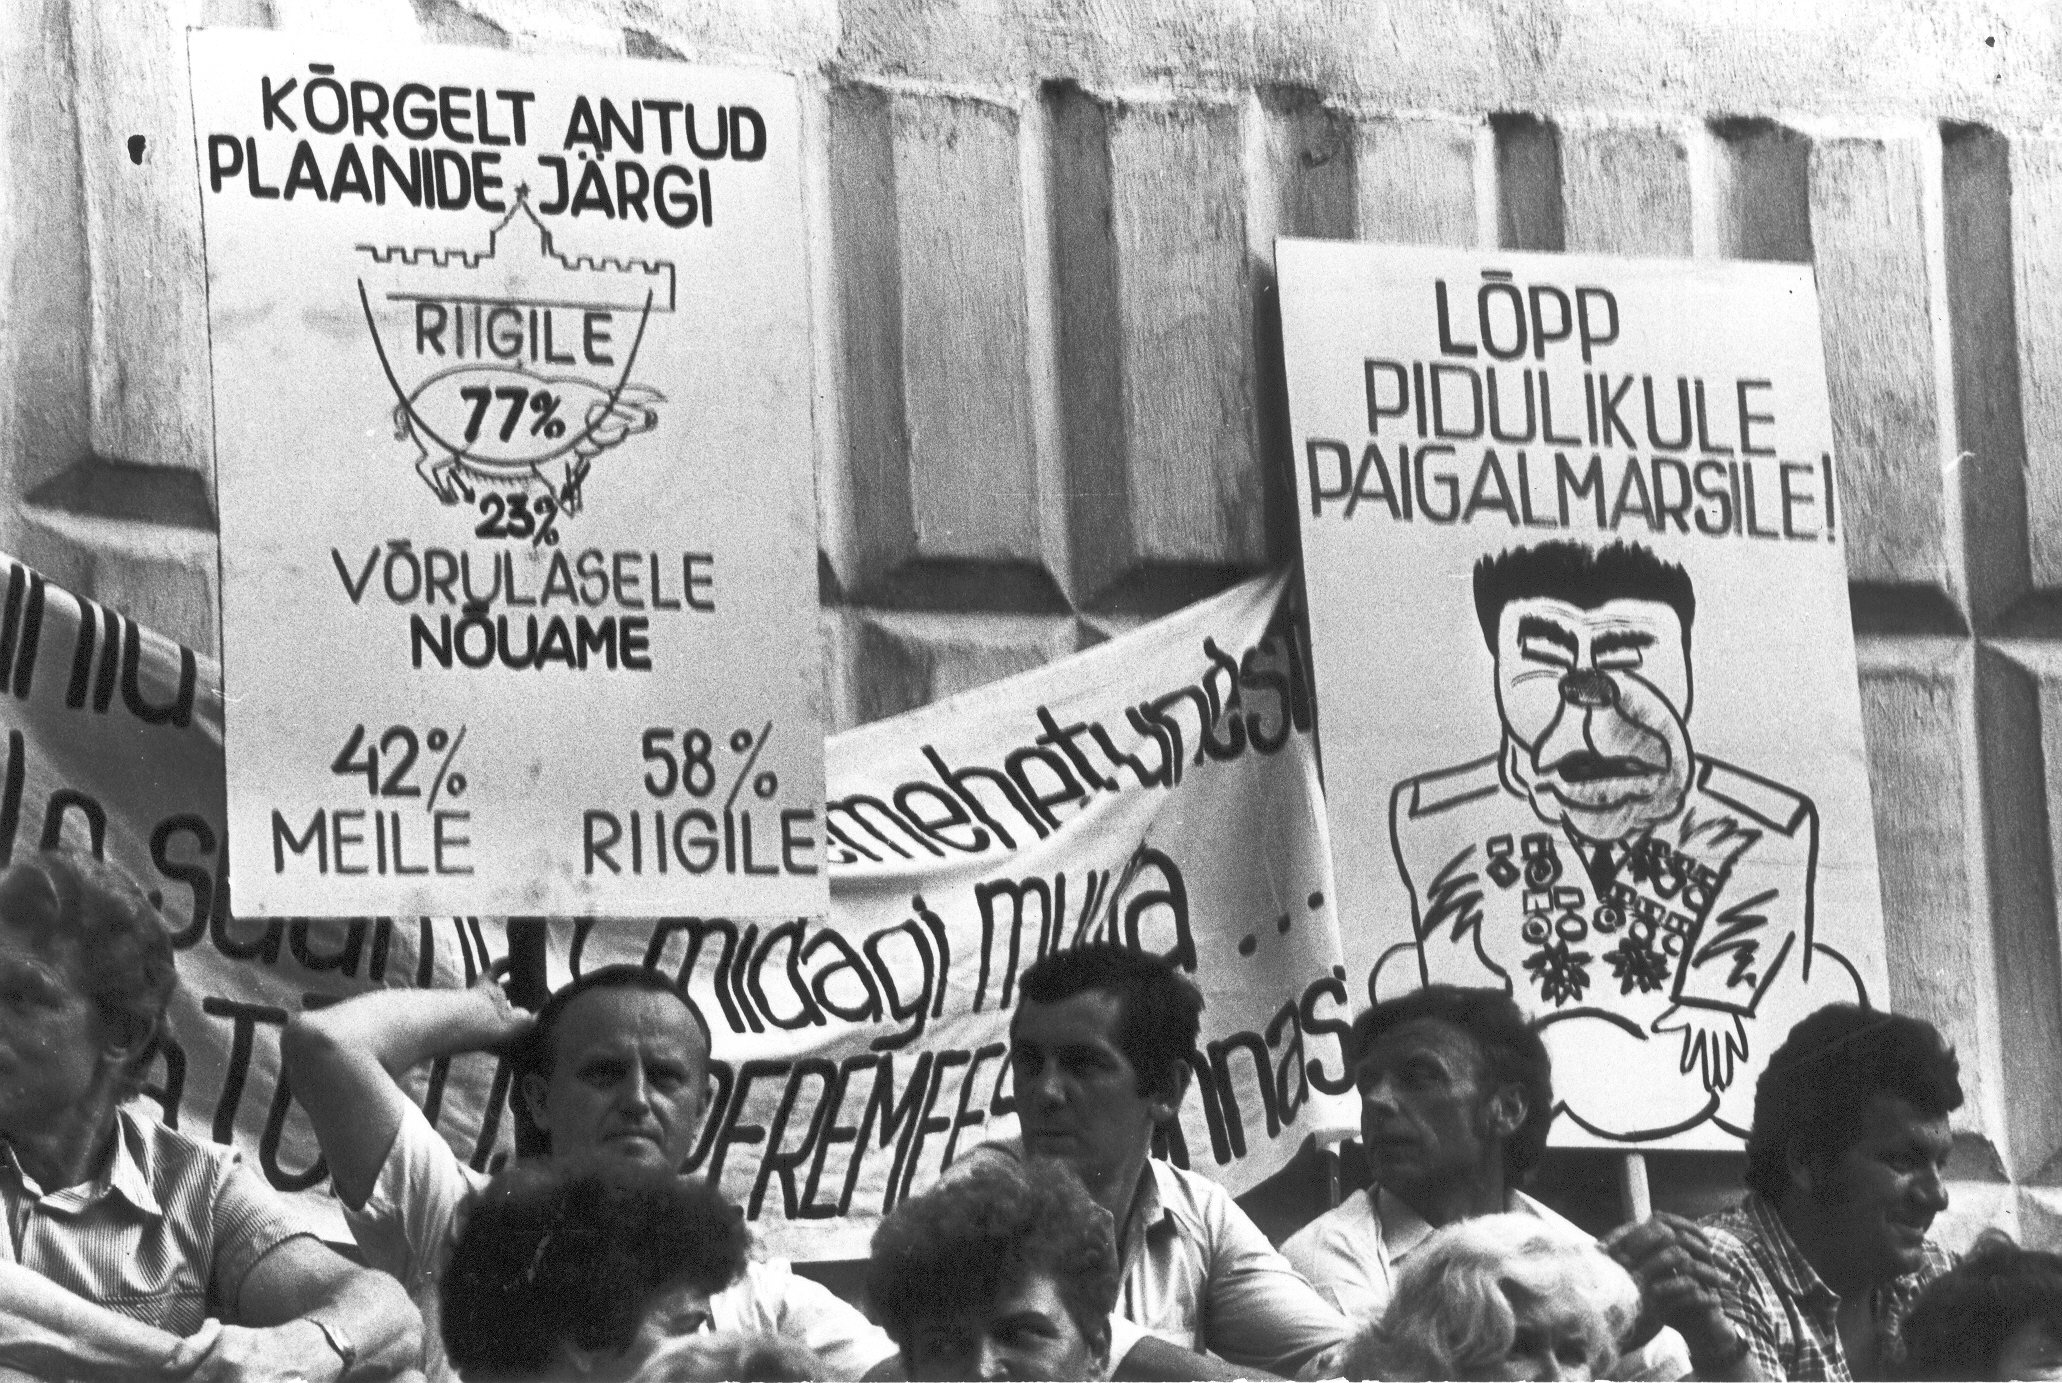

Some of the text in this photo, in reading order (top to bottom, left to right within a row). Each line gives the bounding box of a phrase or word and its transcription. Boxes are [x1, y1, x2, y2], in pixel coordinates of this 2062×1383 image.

[564, 95, 767, 162] ANTUD
[208, 134, 713, 228] PLAANIDE JÄRGI
[415, 303, 615, 366] RIIGILE
[460, 386, 567, 442] 77%
[1364, 357, 1776, 458] PIDULIKULE
[475, 493, 560, 547] 23%
[1305, 437, 1837, 544] PAIGALMARSILE!
[330, 720, 779, 812] 42% 58%
[271, 807, 819, 876] MEILE RIIGILE
